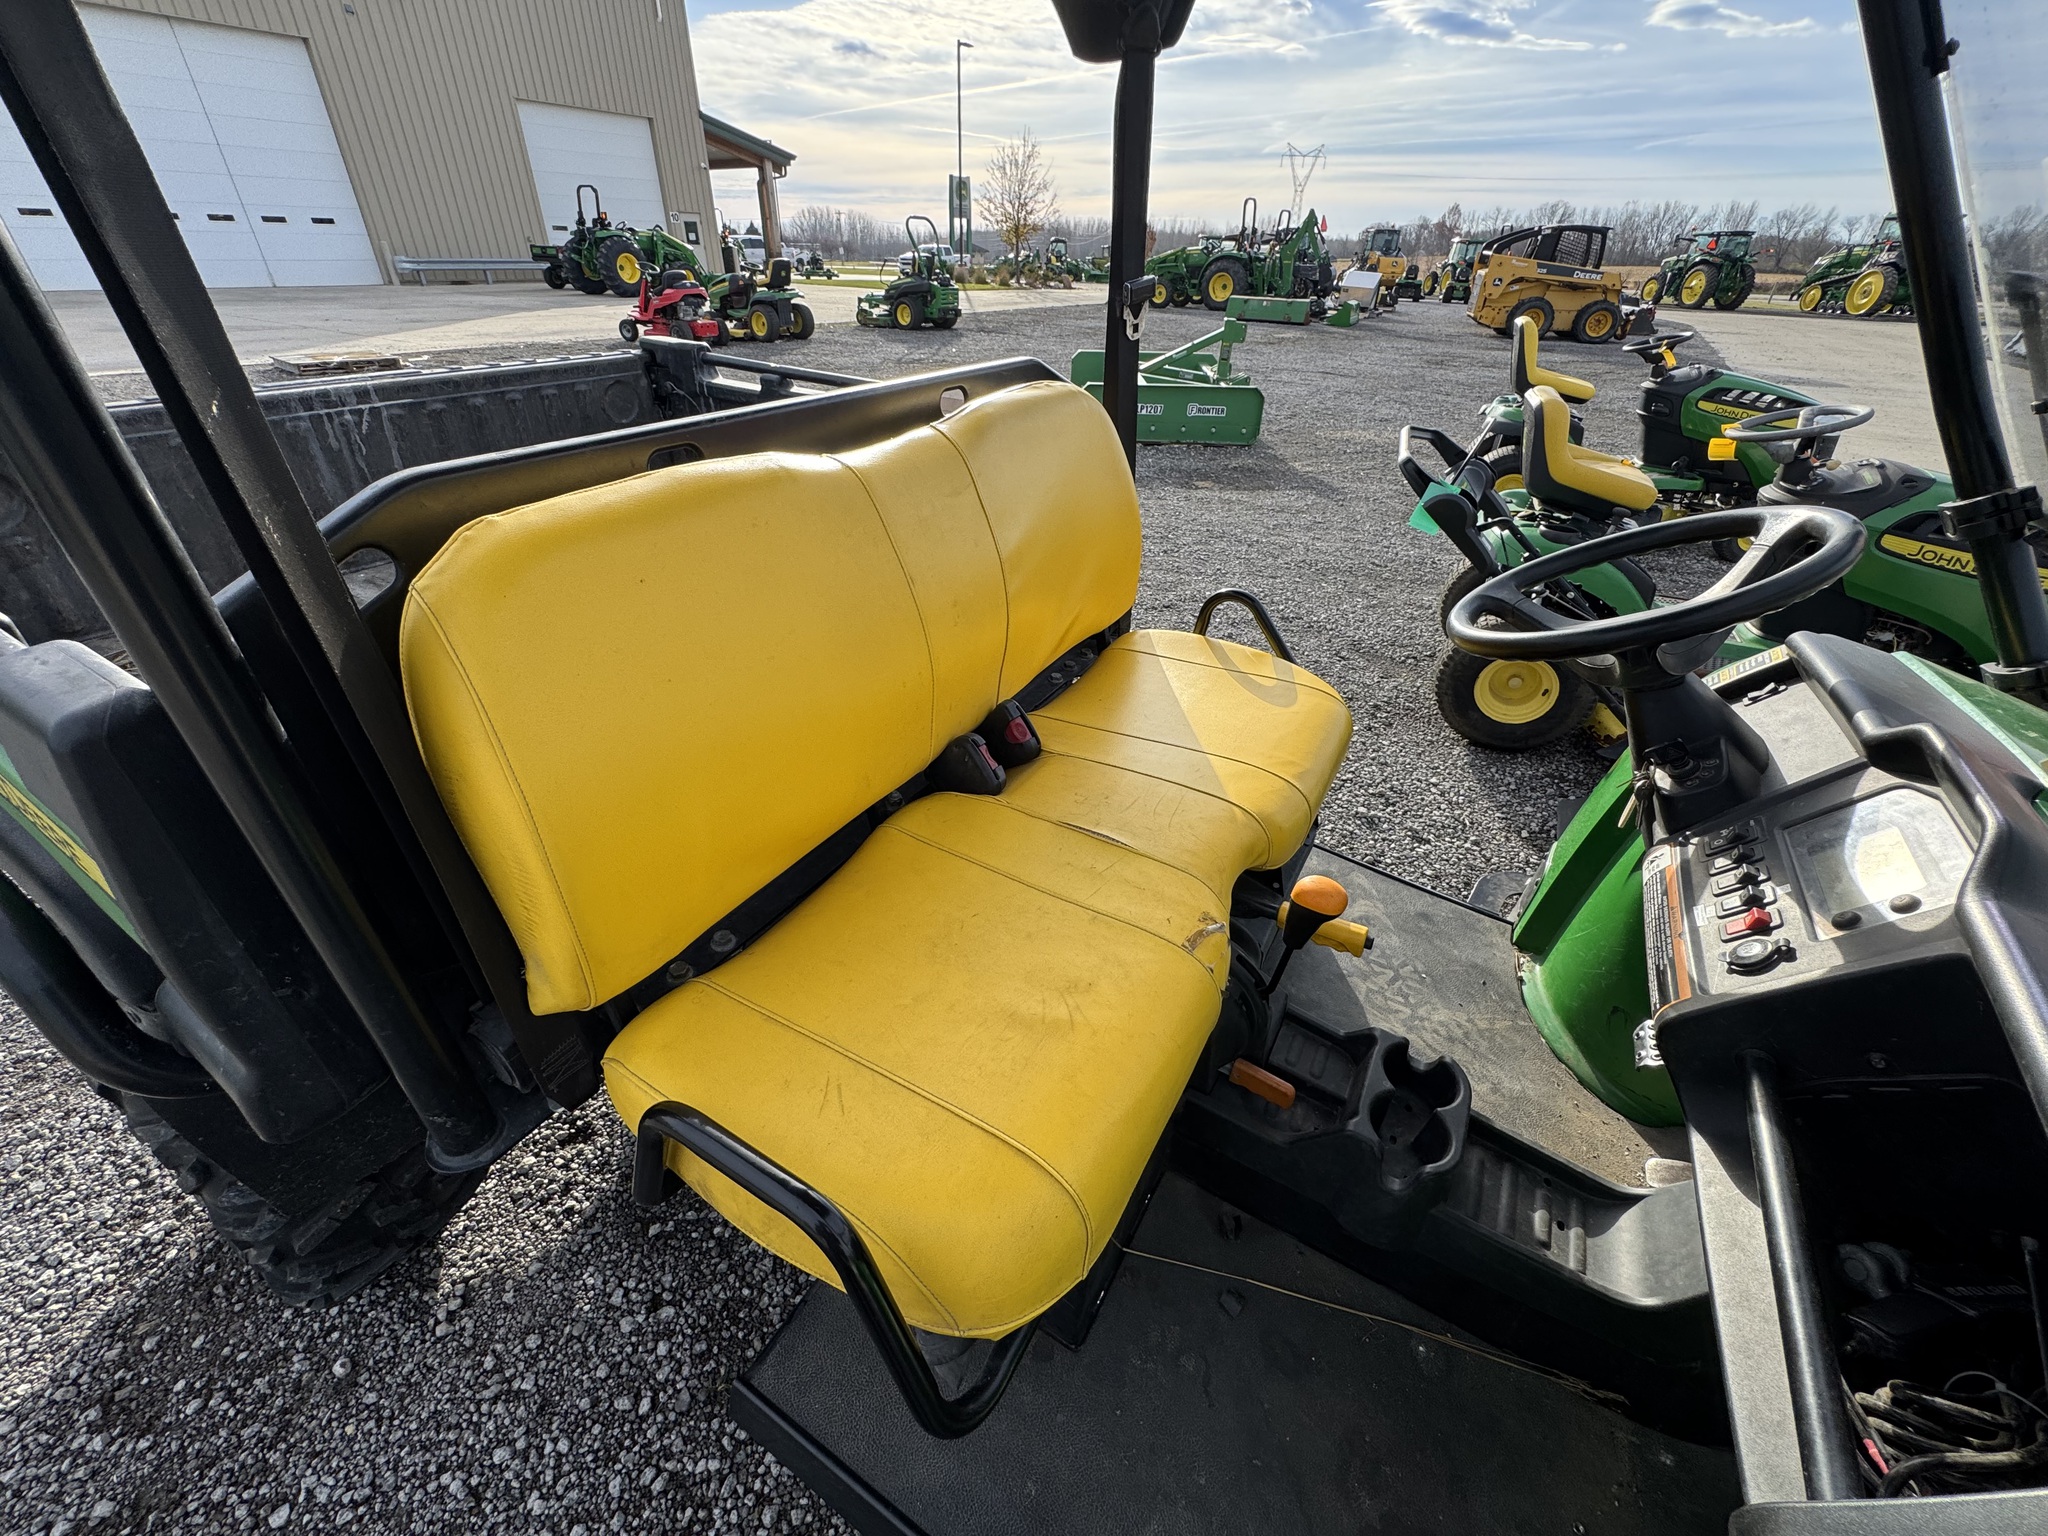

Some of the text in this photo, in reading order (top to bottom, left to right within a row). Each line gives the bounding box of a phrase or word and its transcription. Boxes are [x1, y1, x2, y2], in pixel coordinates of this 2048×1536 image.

[671, 213, 679, 222] 10
[1573, 270, 1603, 281] DEERE
[1188, 404, 1226, 416] FRONTIER
[1711, 405, 1738, 418] JOHN
[1907, 545, 1971, 570] JOHN
